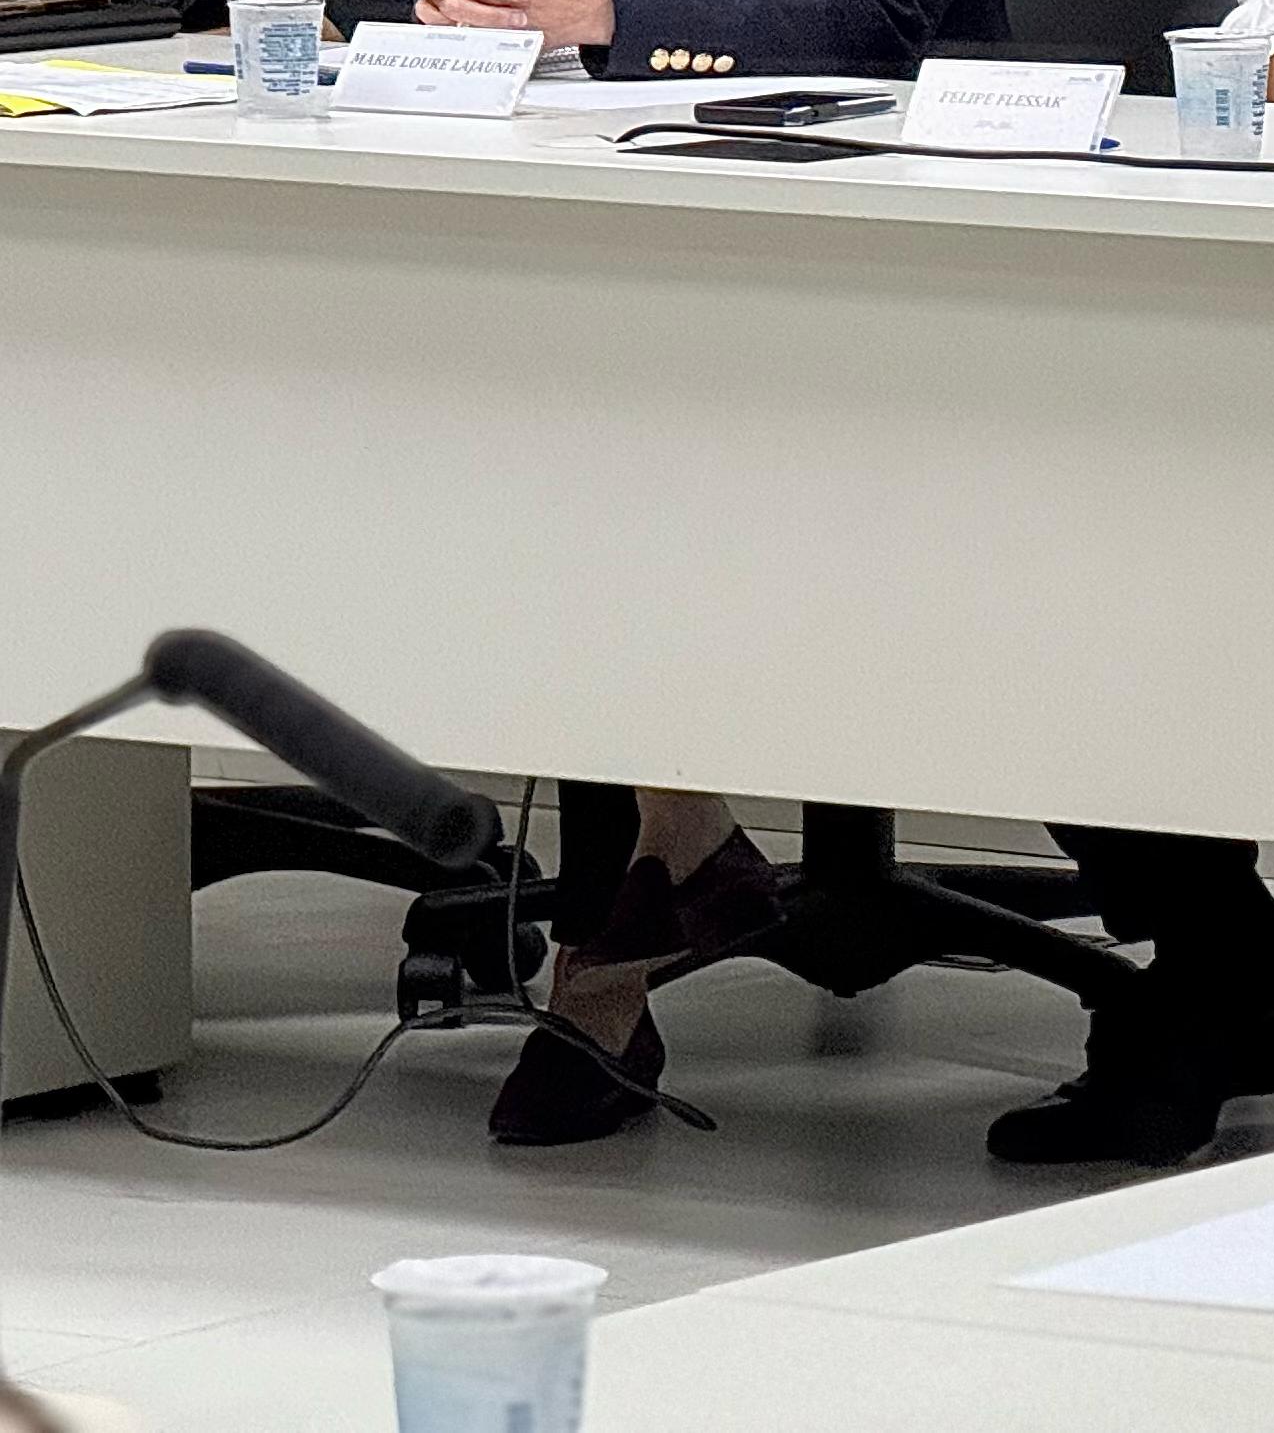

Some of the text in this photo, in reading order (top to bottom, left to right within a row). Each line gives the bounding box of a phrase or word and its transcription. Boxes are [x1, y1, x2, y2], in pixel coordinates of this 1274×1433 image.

[350, 52, 400, 67] MARIE
[449, 59, 523, 76] LAJAUNIE
[938, 90, 995, 106] FELIPE
